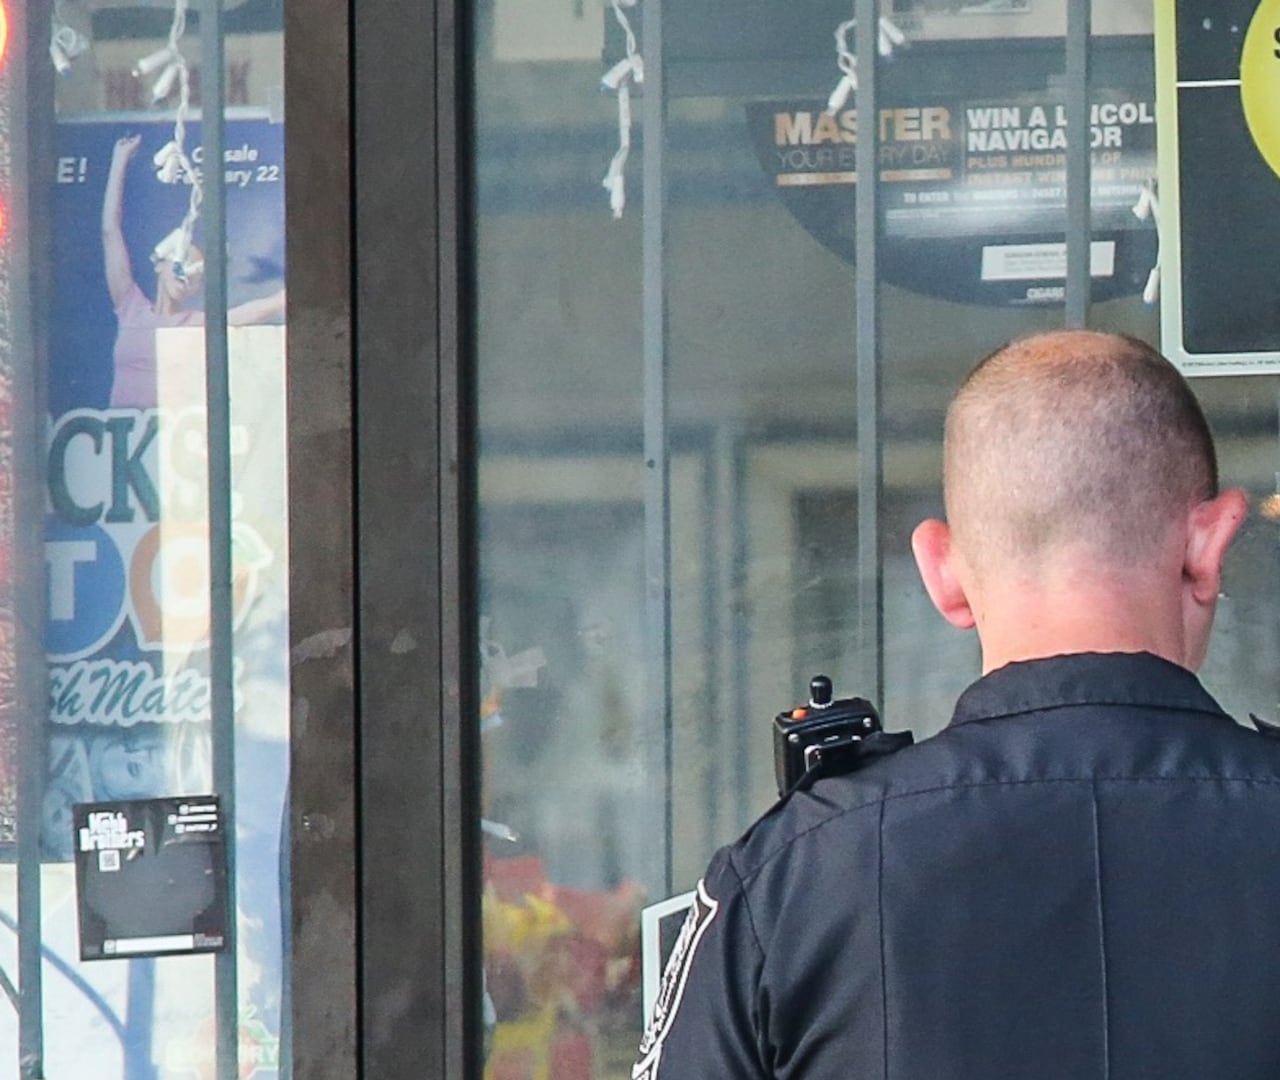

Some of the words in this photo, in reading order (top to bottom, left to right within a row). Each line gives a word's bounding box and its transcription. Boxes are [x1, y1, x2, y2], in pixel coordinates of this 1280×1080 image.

[774, 106, 951, 146] MASTER
[967, 107, 1020, 130] WIN
[1028, 106, 1047, 127] A
[1055, 101, 1158, 128] LCOL
[968, 125, 1122, 152] NAVIGAOR
[777, 149, 832, 169] YOUR
[839, 147, 908, 167] ERY
[256, 165, 281, 183] 22
